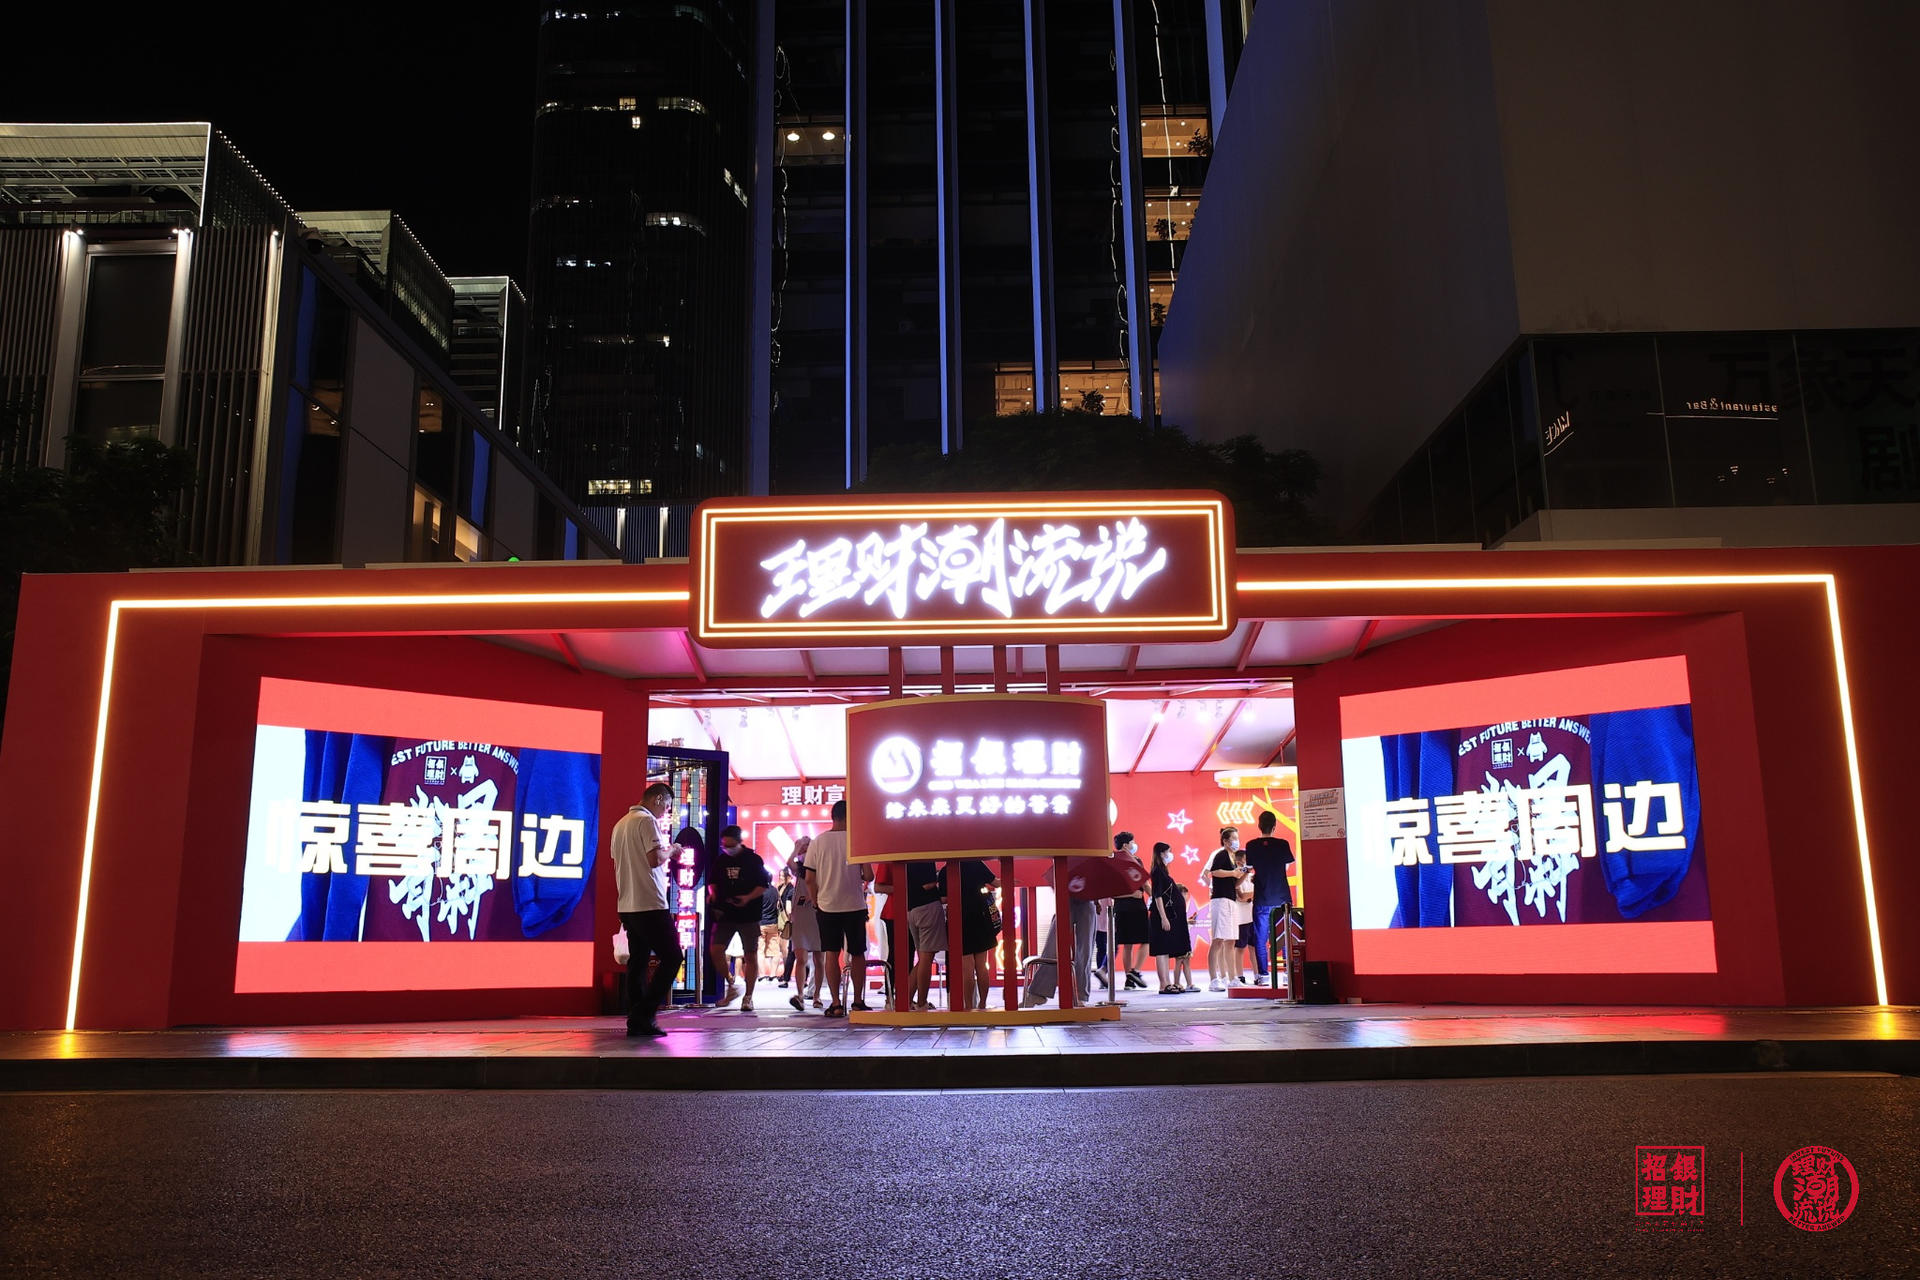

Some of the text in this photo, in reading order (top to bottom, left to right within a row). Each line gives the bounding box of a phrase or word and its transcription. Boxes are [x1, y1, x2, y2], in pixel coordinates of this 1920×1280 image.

[760, 517, 1167, 618] 理财潮流说
[415, 740, 455, 758] FUTURE
[1479, 720, 1519, 744] FUTURE
[266, 800, 585, 880] 惊喜周边
[1361, 780, 1687, 867] 惊喜周边
